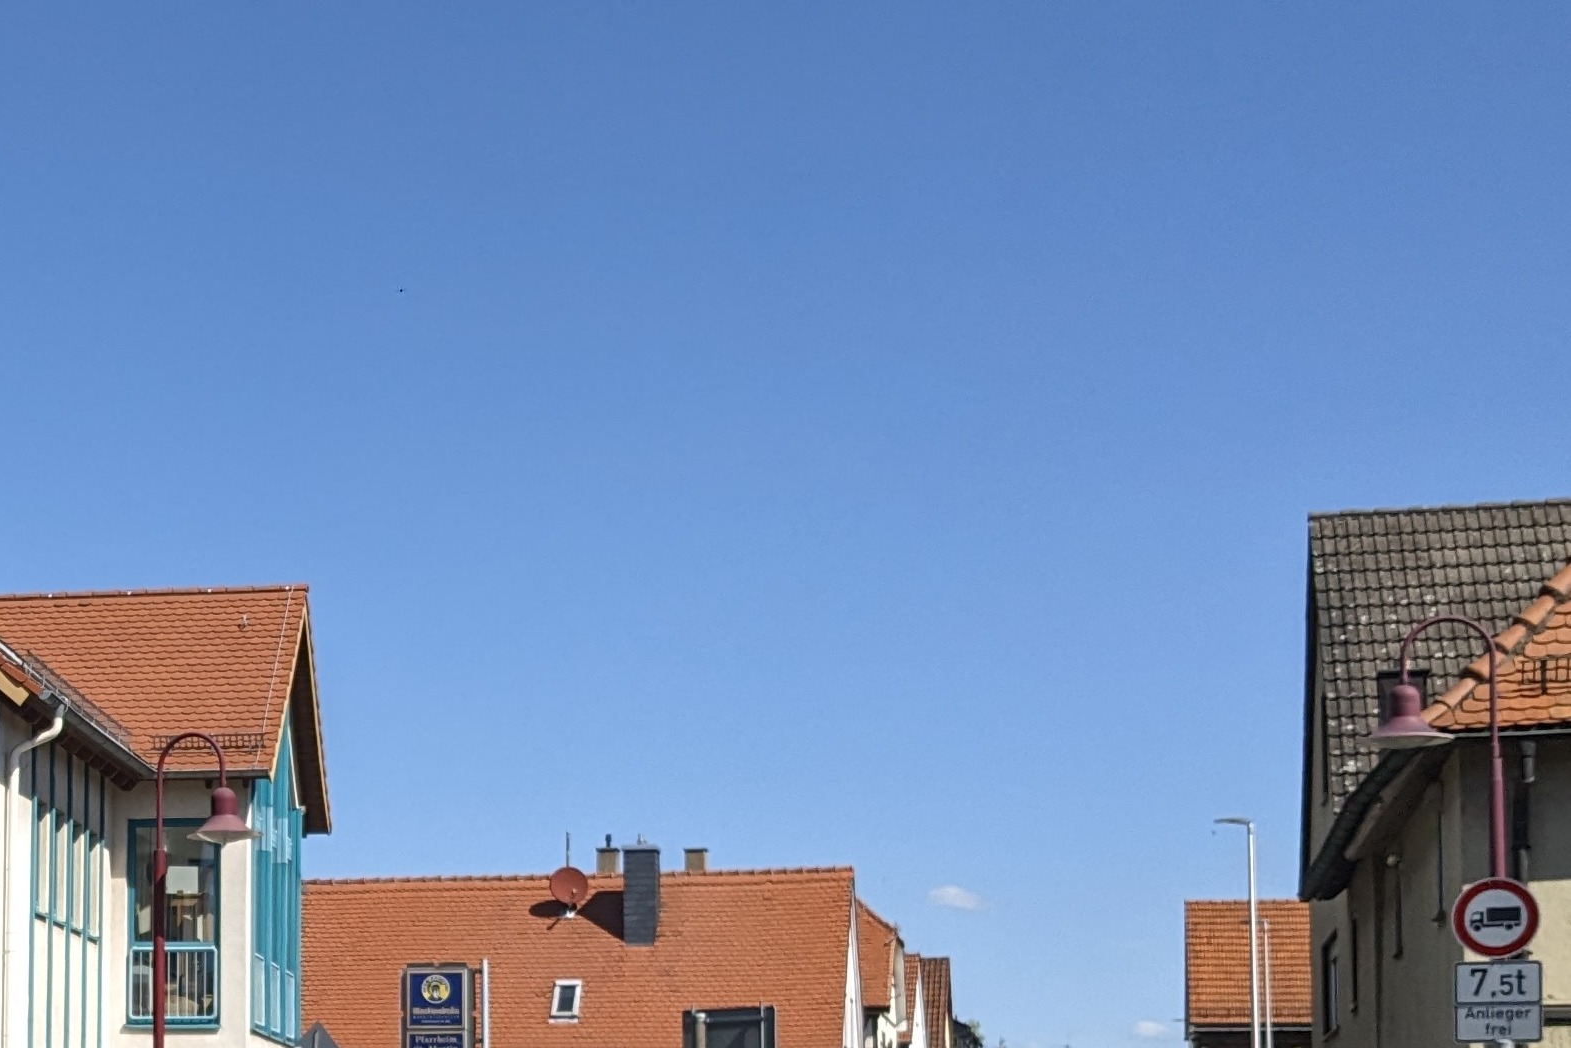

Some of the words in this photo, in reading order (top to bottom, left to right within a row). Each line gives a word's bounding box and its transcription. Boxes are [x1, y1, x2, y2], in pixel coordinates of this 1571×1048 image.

[1470, 968, 1527, 999] 7,5t
[1464, 1007, 1531, 1021] Anlieger
[1485, 1024, 1512, 1036] frei
